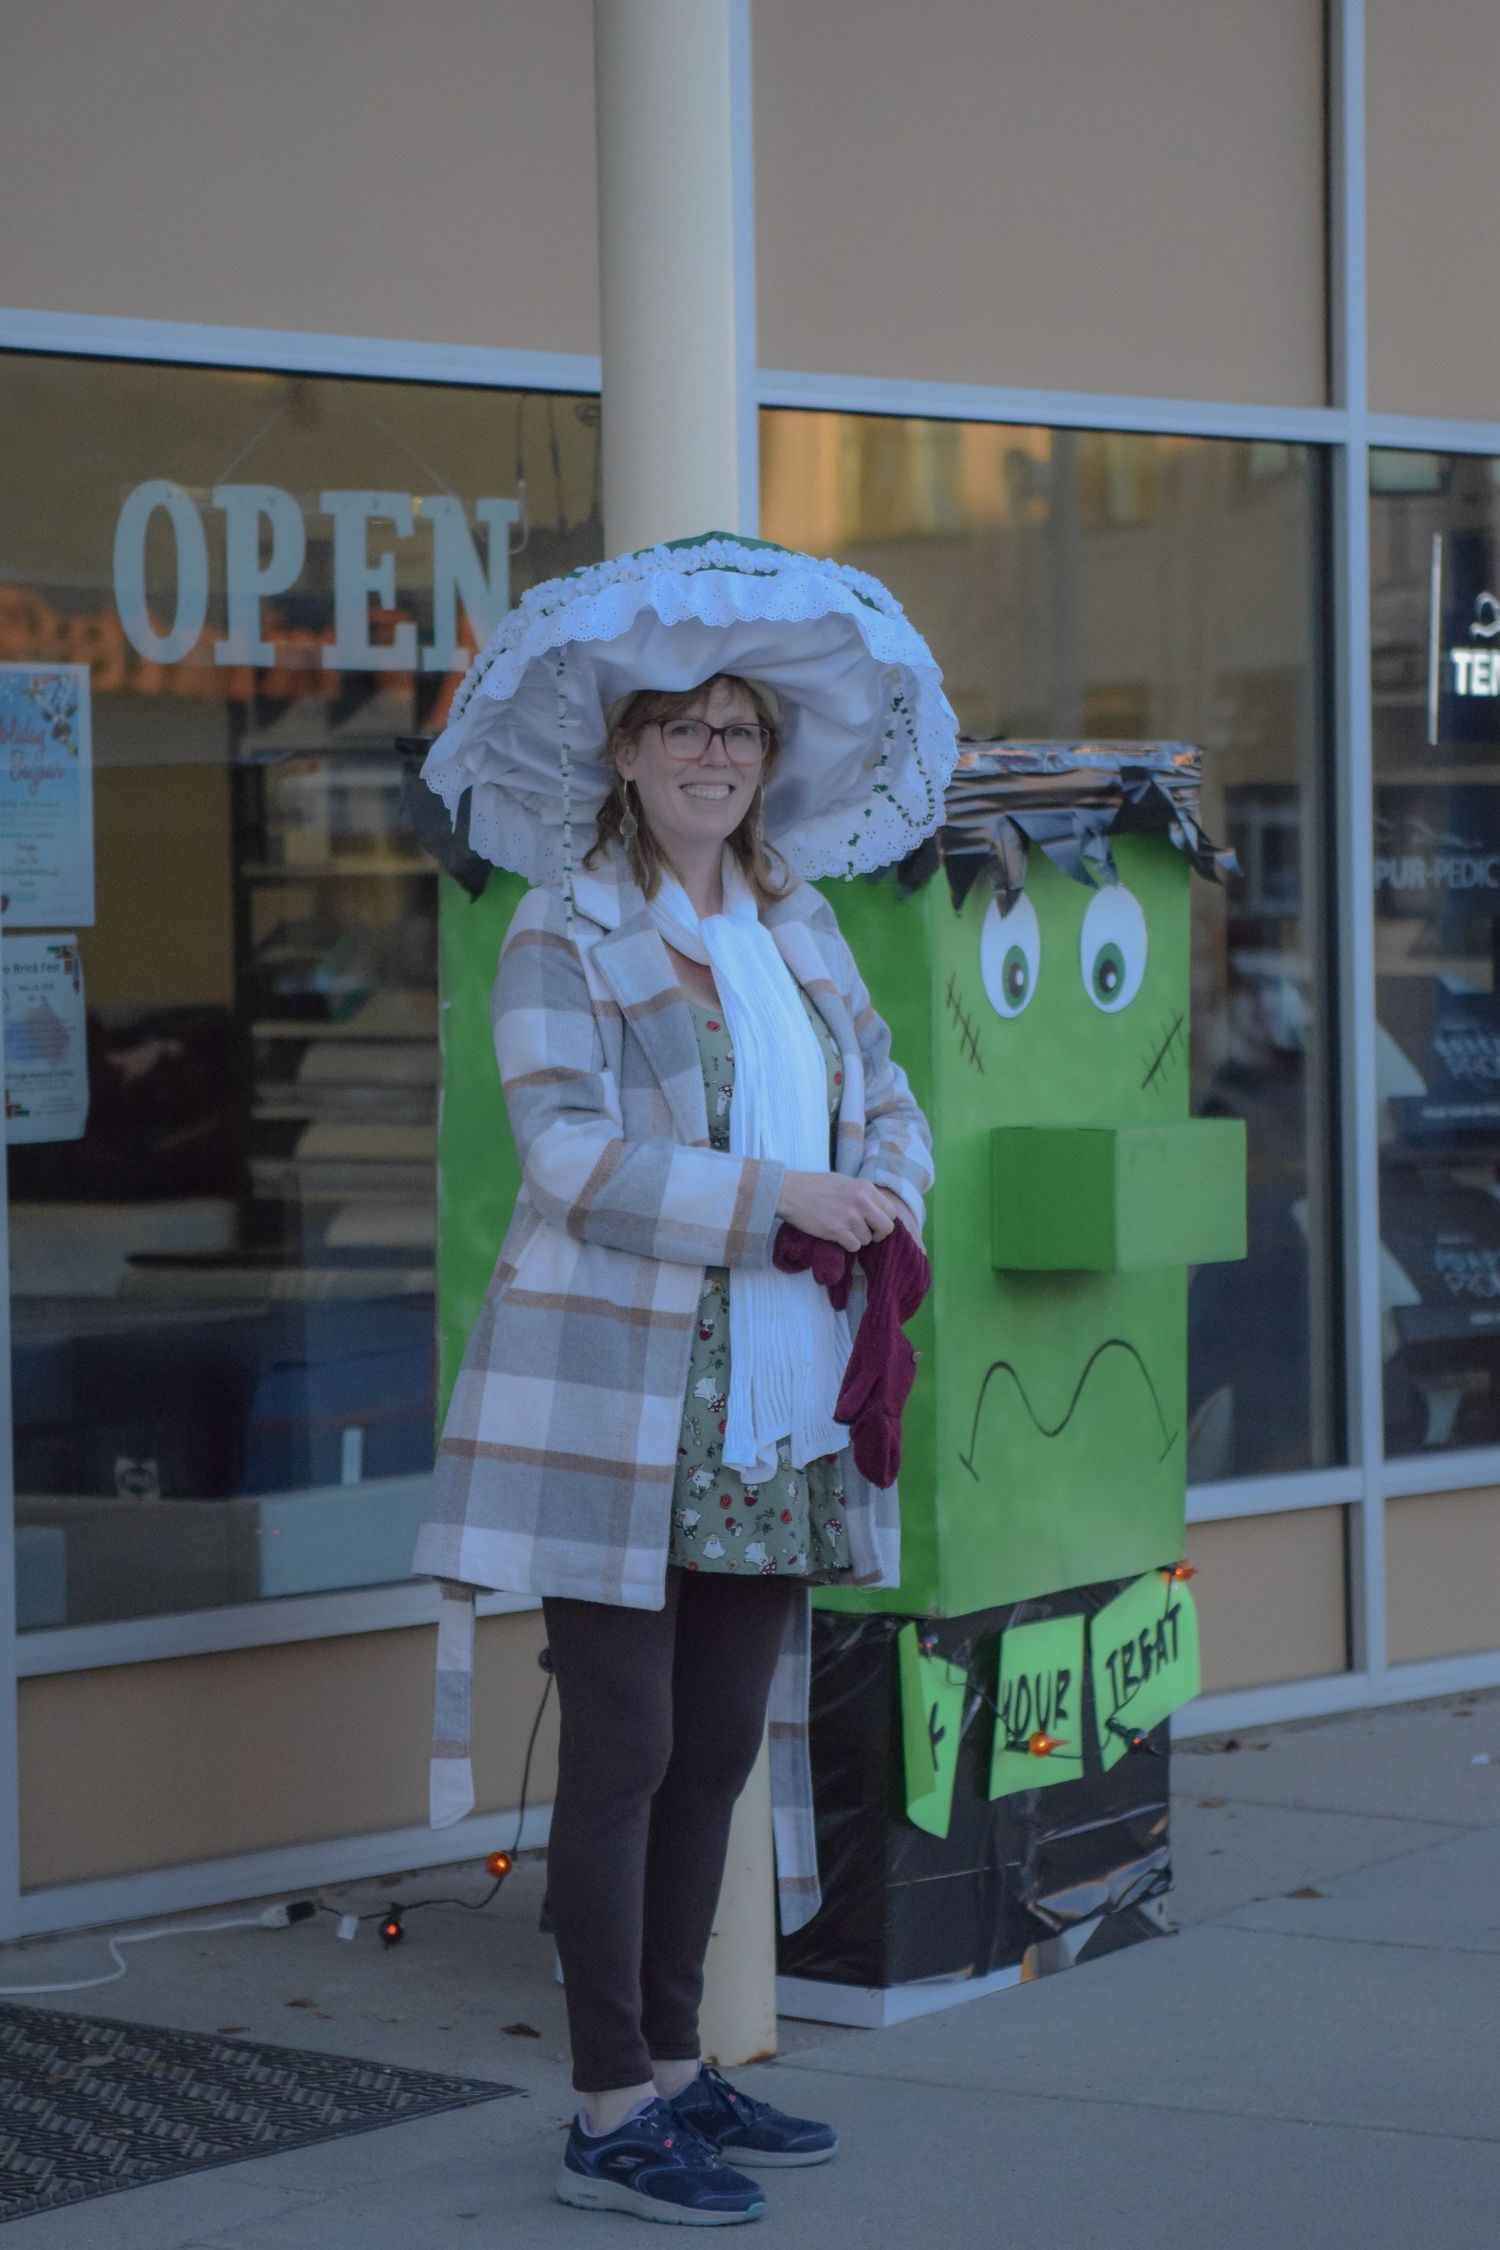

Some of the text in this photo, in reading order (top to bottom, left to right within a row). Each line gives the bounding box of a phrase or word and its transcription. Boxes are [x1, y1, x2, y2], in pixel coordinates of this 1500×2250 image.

[113, 478, 520, 672] OPEN
[1001, 1668, 1072, 1739] YOUR
[1105, 1602, 1182, 1712] TREAT
